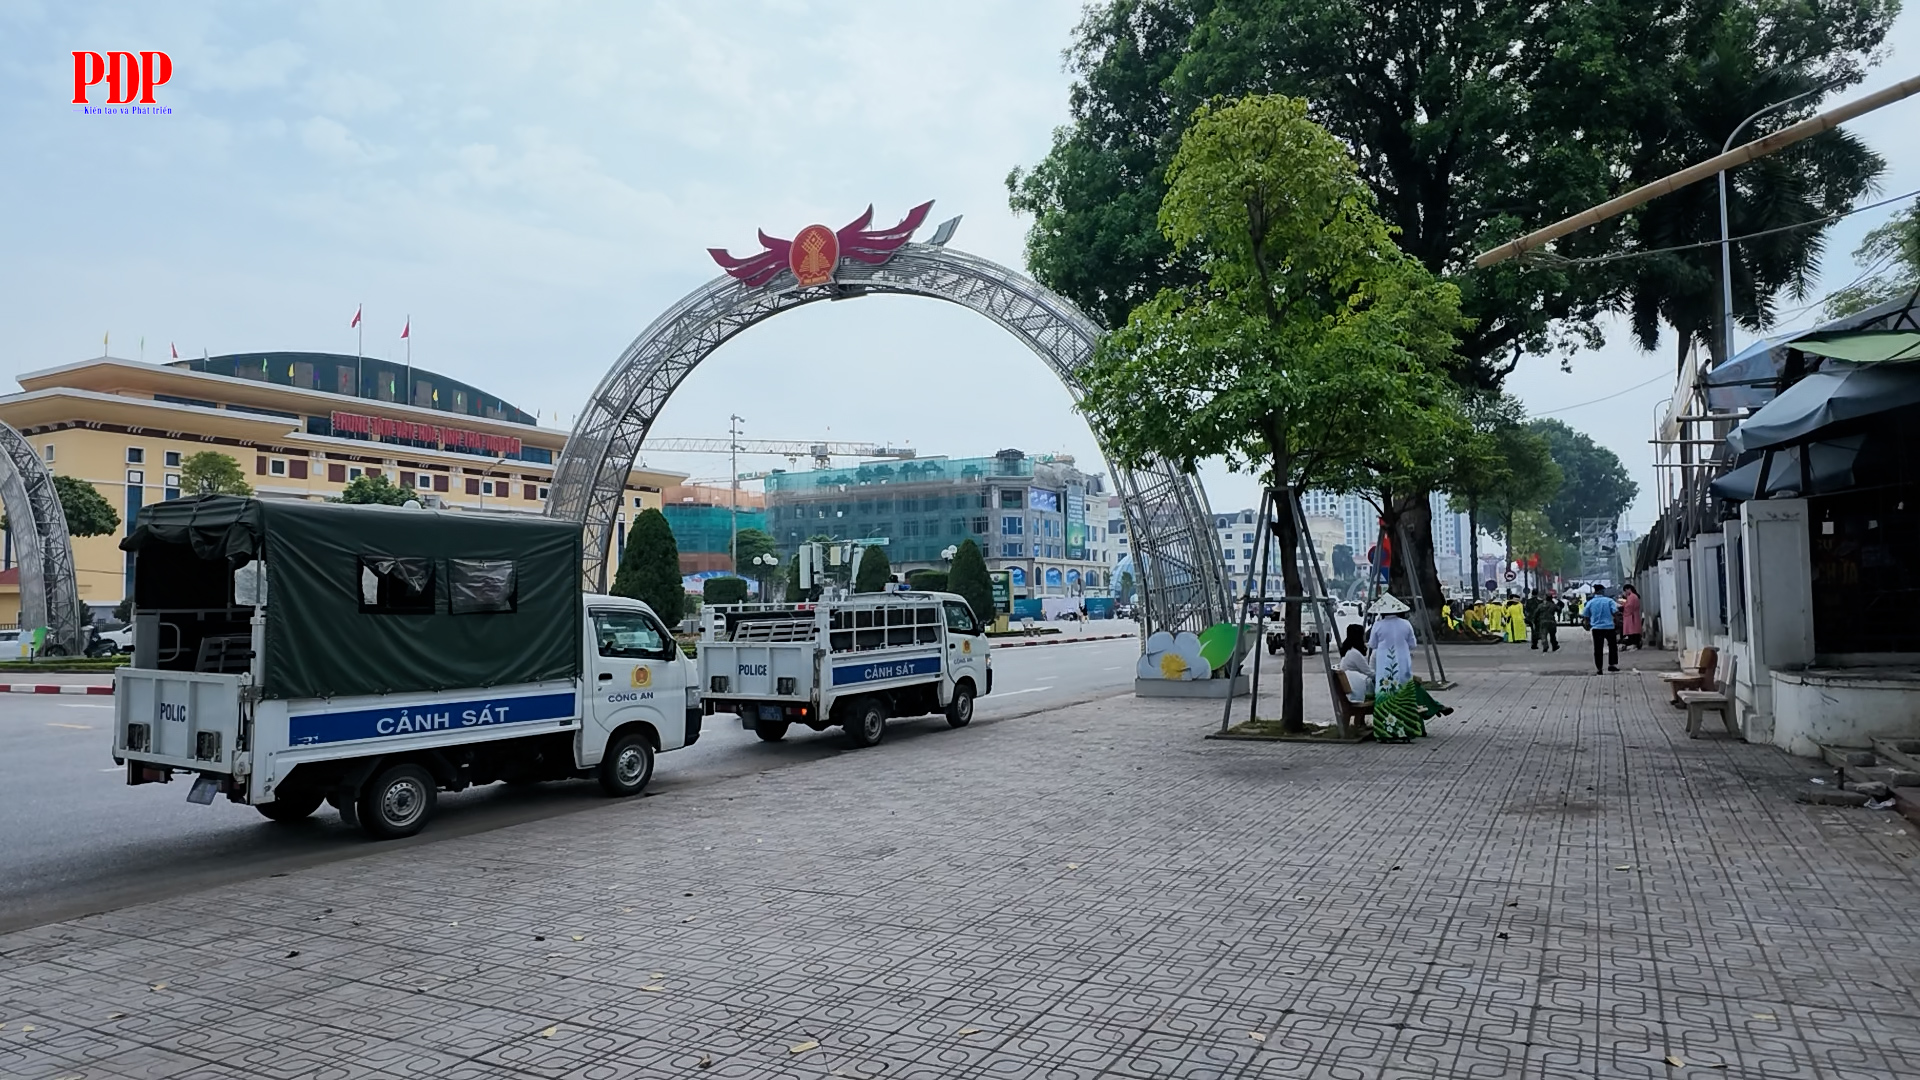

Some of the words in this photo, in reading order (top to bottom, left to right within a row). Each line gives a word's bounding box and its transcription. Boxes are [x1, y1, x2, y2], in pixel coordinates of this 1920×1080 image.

[738, 665, 767, 676] POLICE
[864, 664, 893, 680] CẢNH
[896, 661, 916, 676] SÁT
[608, 692, 637, 702] CÔNG
[640, 692, 654, 700] AN
[160, 703, 186, 722] POLIC
[376, 710, 450, 734] CẢNH
[462, 704, 509, 726] SÁT
